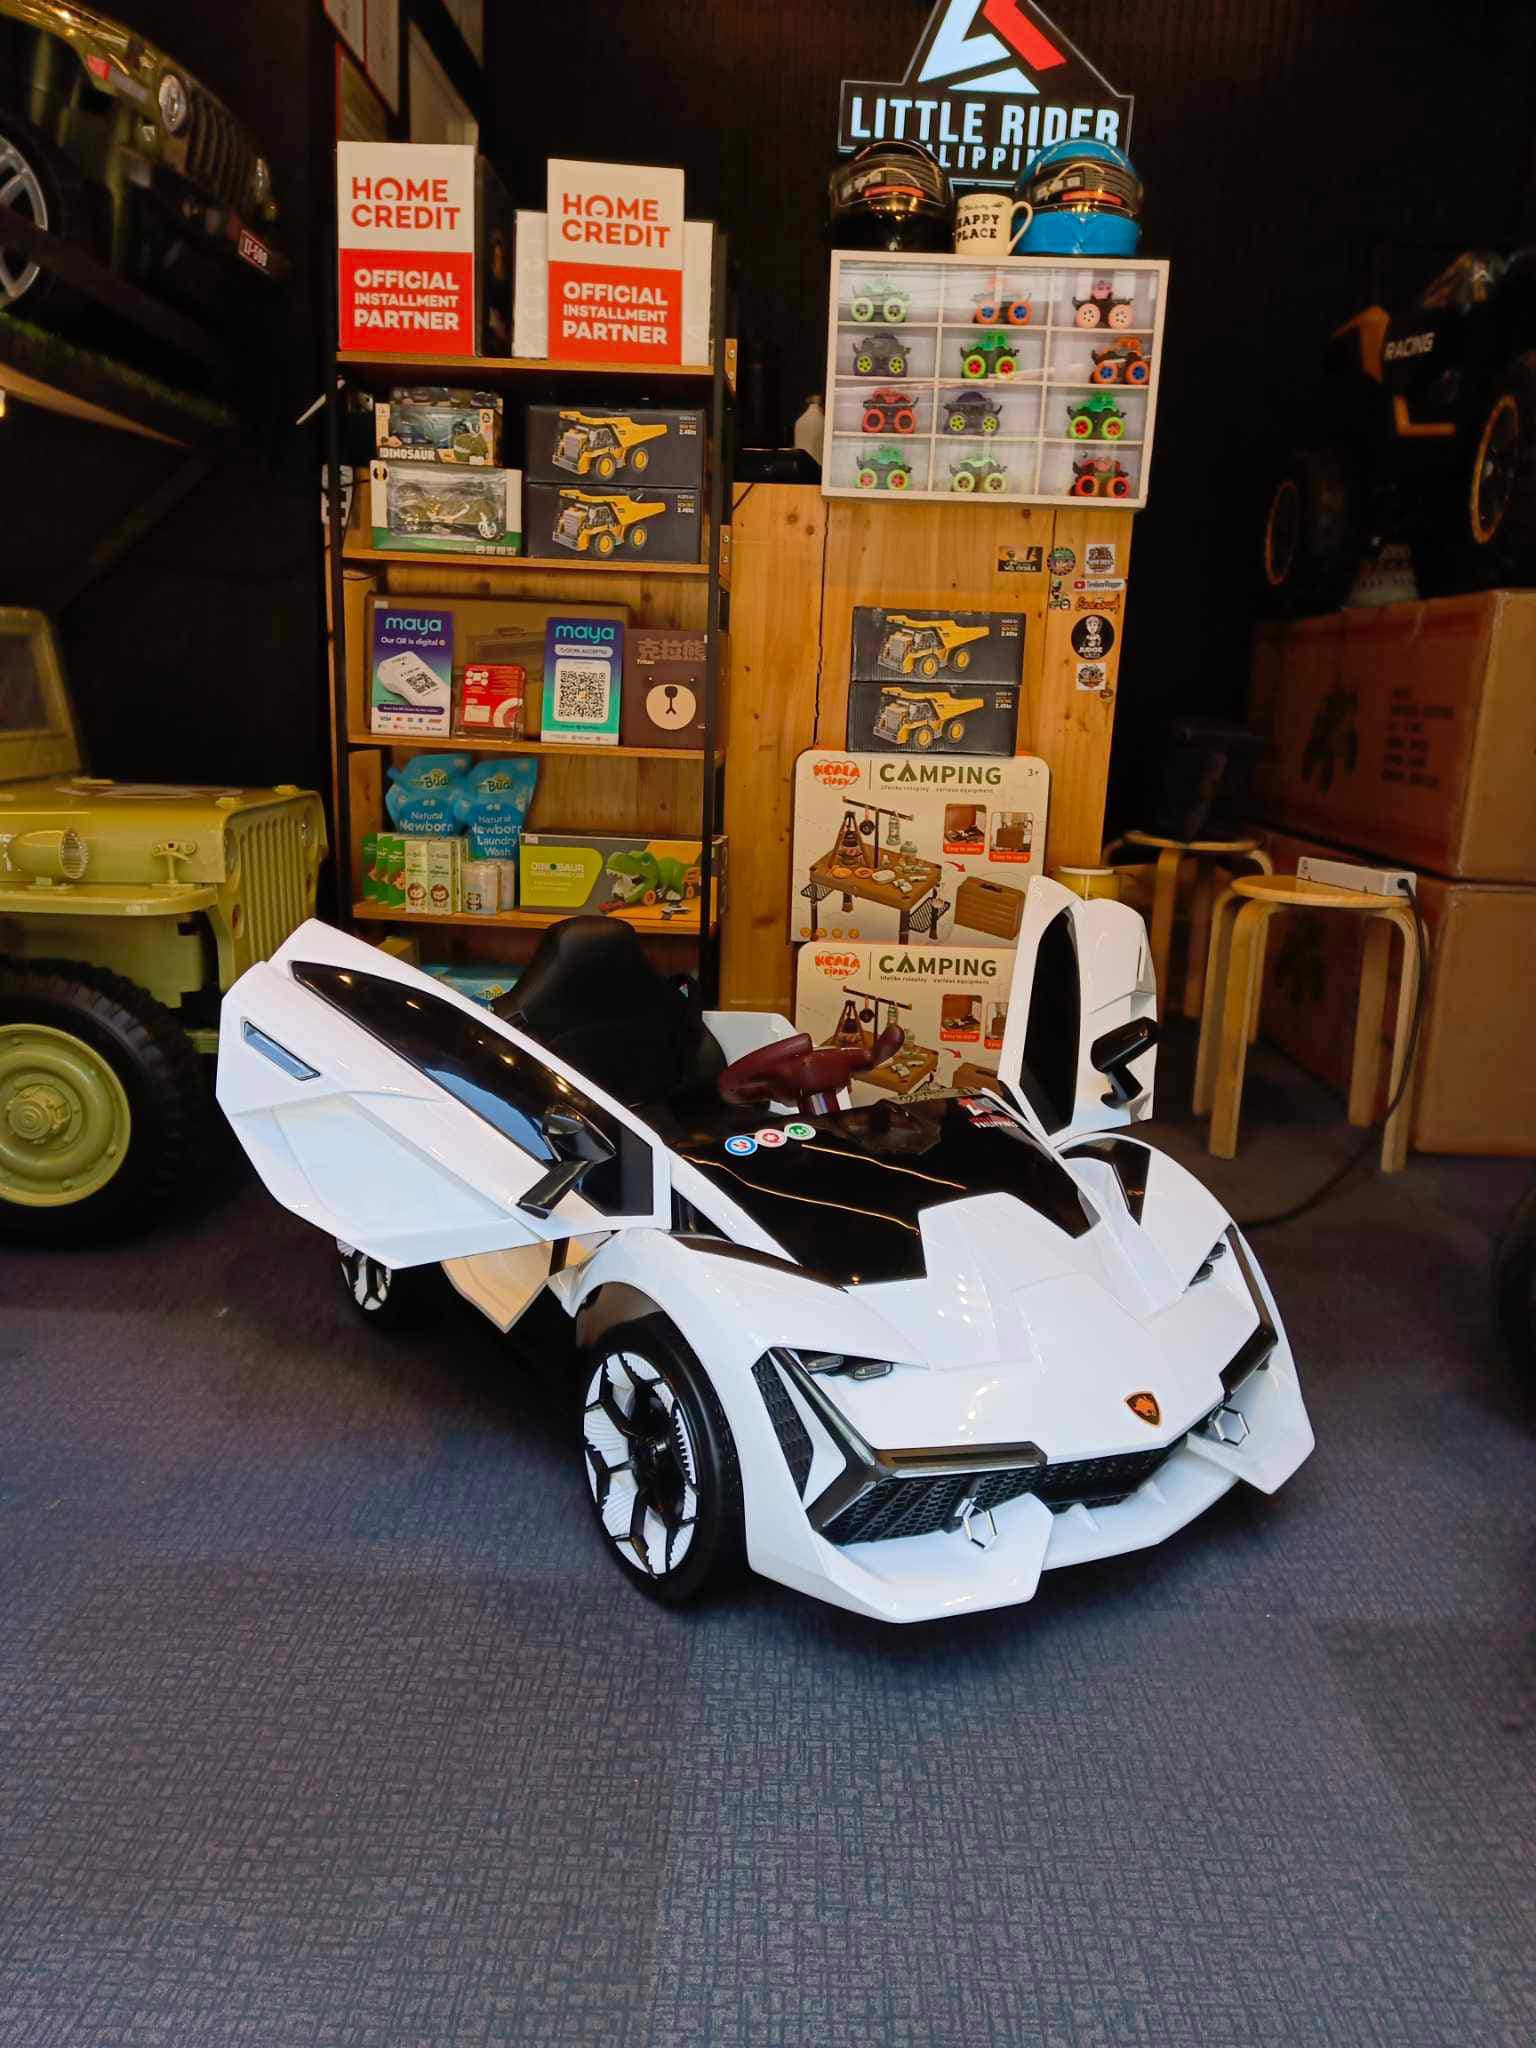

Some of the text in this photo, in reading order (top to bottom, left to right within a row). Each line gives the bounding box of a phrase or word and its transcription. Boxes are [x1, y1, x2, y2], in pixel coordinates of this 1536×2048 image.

[850, 96, 1120, 147] LITTLE RIDER
[352, 176, 449, 203] HOME
[351, 203, 461, 230] CREDIT
[562, 192, 659, 222] HOME
[562, 219, 671, 249] CREDIT
[353, 268, 460, 291] OFFICIAL
[354, 292, 459, 308] INSTALLMENT
[563, 280, 668, 306] OFFICIAL
[354, 308, 460, 331] PARTNER
[563, 303, 668, 323] INSTALLMENT
[562, 320, 668, 345] PARTNER
[1384, 331, 1435, 360] RACING
[380, 448, 436, 460] DINOSAUR
[385, 617, 442, 635] maya
[555, 623, 615, 644] maya
[880, 760, 1001, 786] CAMPING
[400, 820, 454, 832] Newborn
[878, 952, 997, 977] CAMPING
